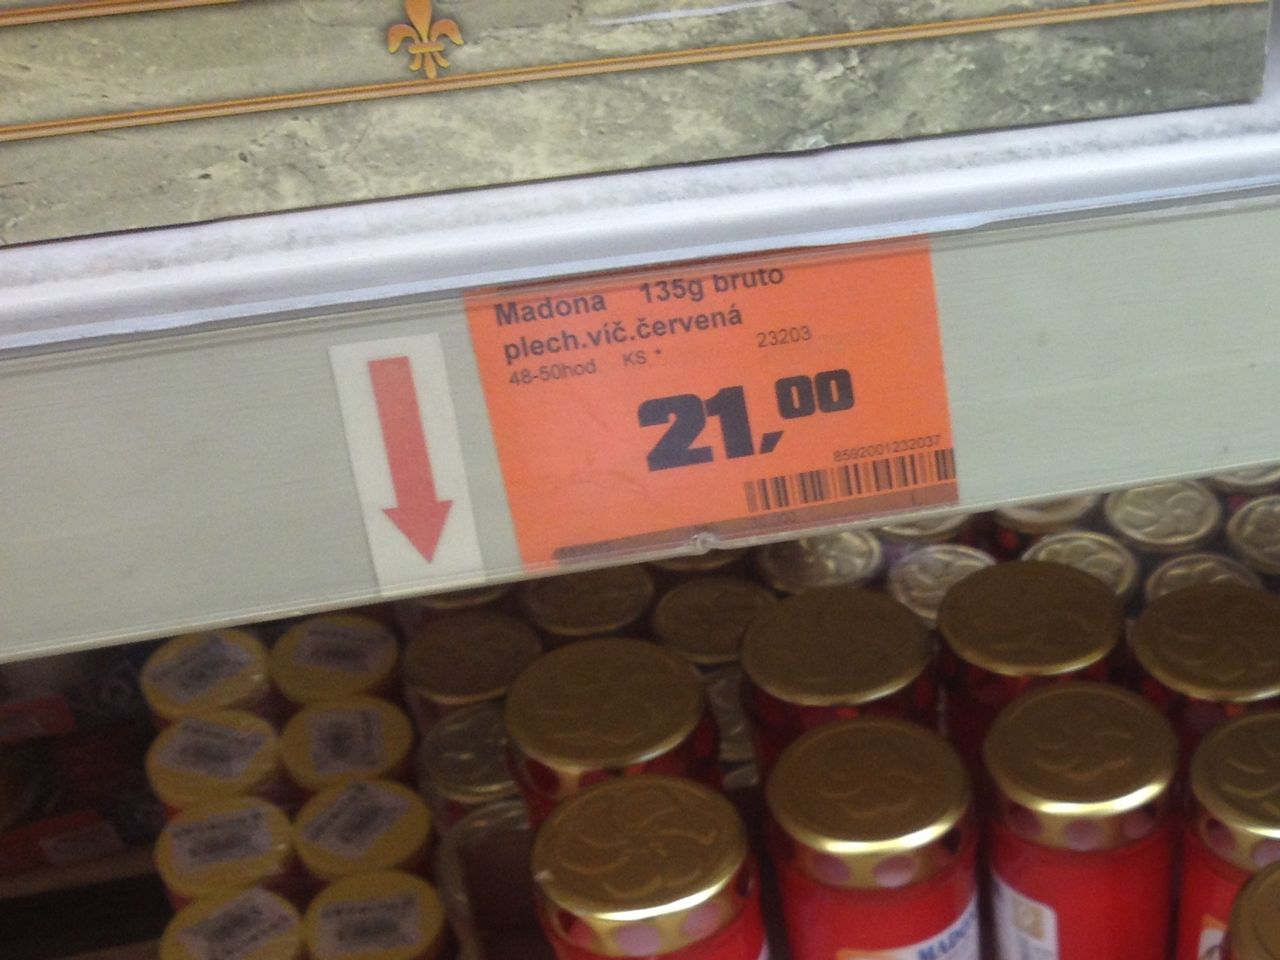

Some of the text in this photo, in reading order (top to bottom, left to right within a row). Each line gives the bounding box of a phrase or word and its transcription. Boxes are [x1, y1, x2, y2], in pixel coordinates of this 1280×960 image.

[494, 267, 784, 327] Madona 135g bruto
[503, 303, 744, 366] plech.víč.červená
[757, 325, 813, 348] 23203
